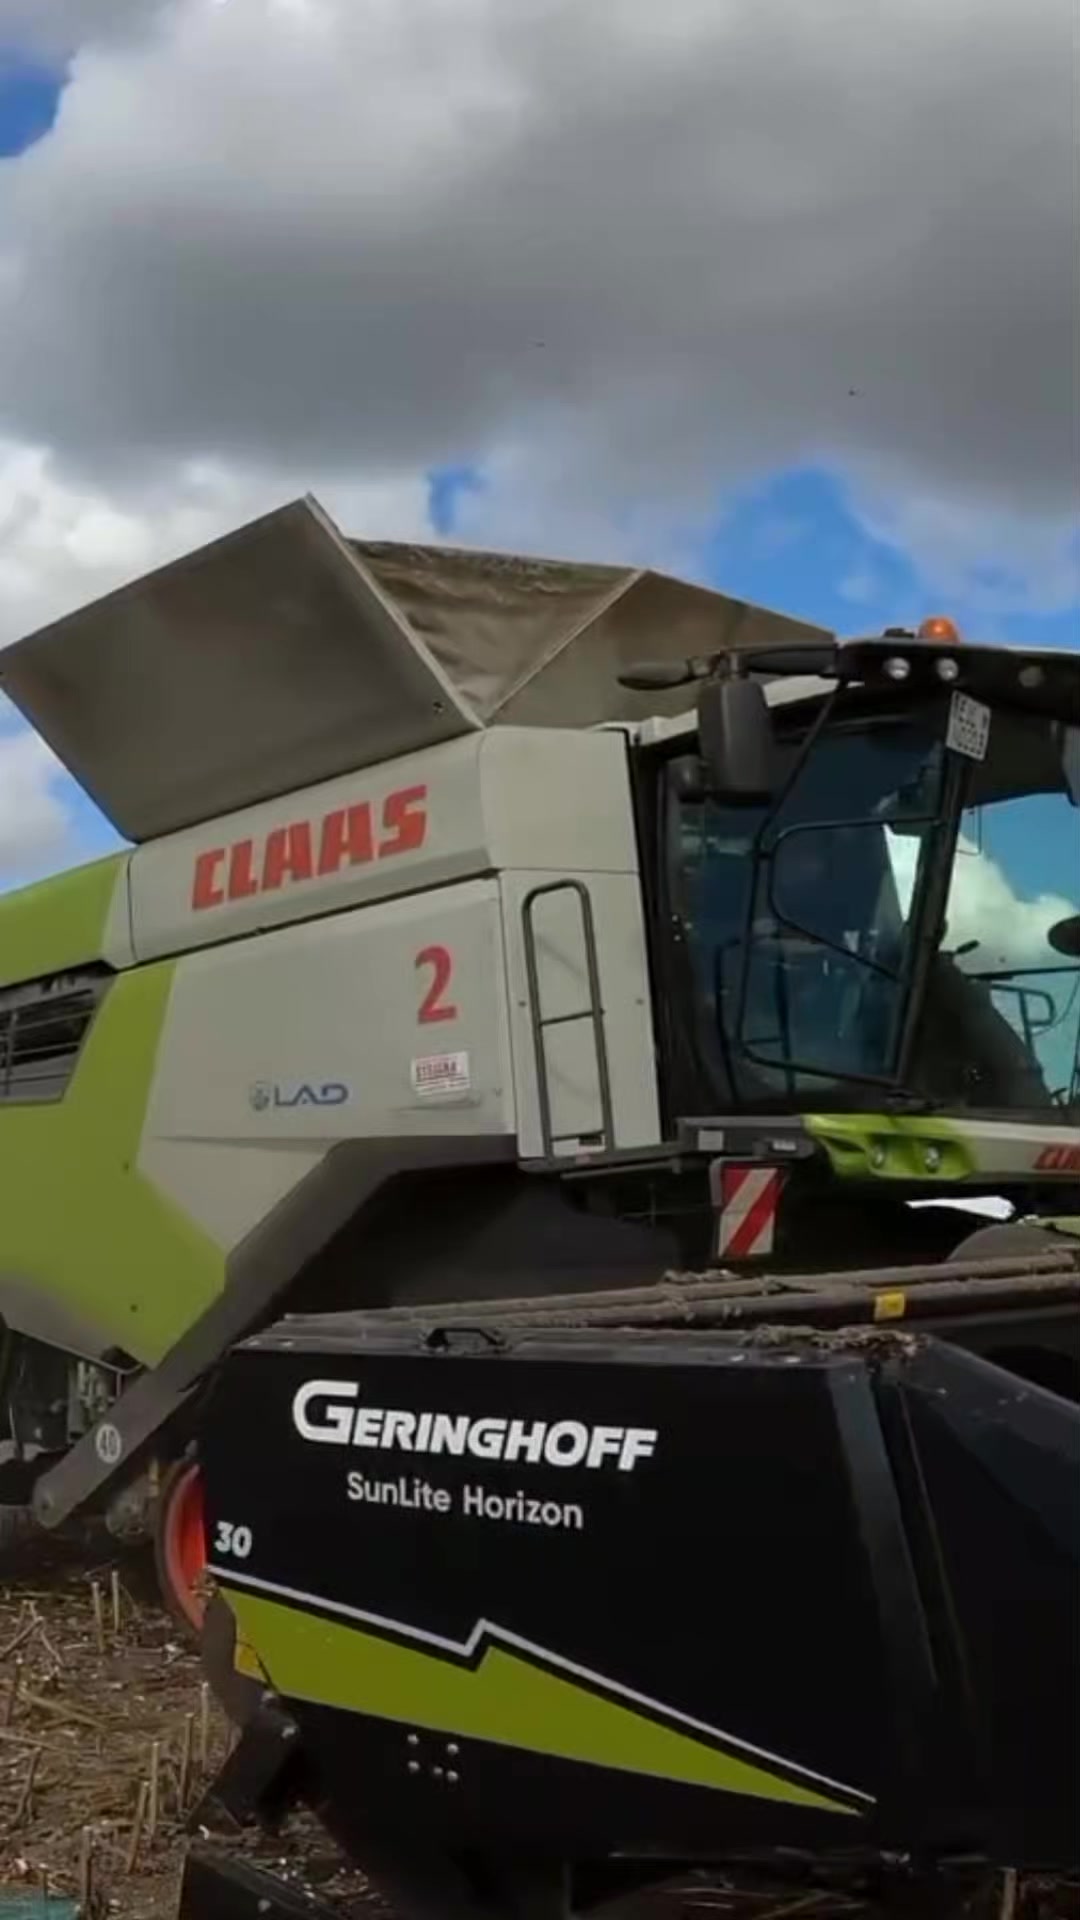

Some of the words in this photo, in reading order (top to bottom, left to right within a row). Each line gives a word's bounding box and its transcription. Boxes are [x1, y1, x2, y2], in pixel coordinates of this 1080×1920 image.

[193, 784, 427, 910] CLAAS
[415, 945, 457, 1022] 2
[274, 1083, 348, 1106] LAD
[100, 1429, 118, 1457] 40
[347, 1471, 452, 1513] SunLite
[463, 1484, 584, 1530] Horizon
[214, 1520, 253, 1558] 30
